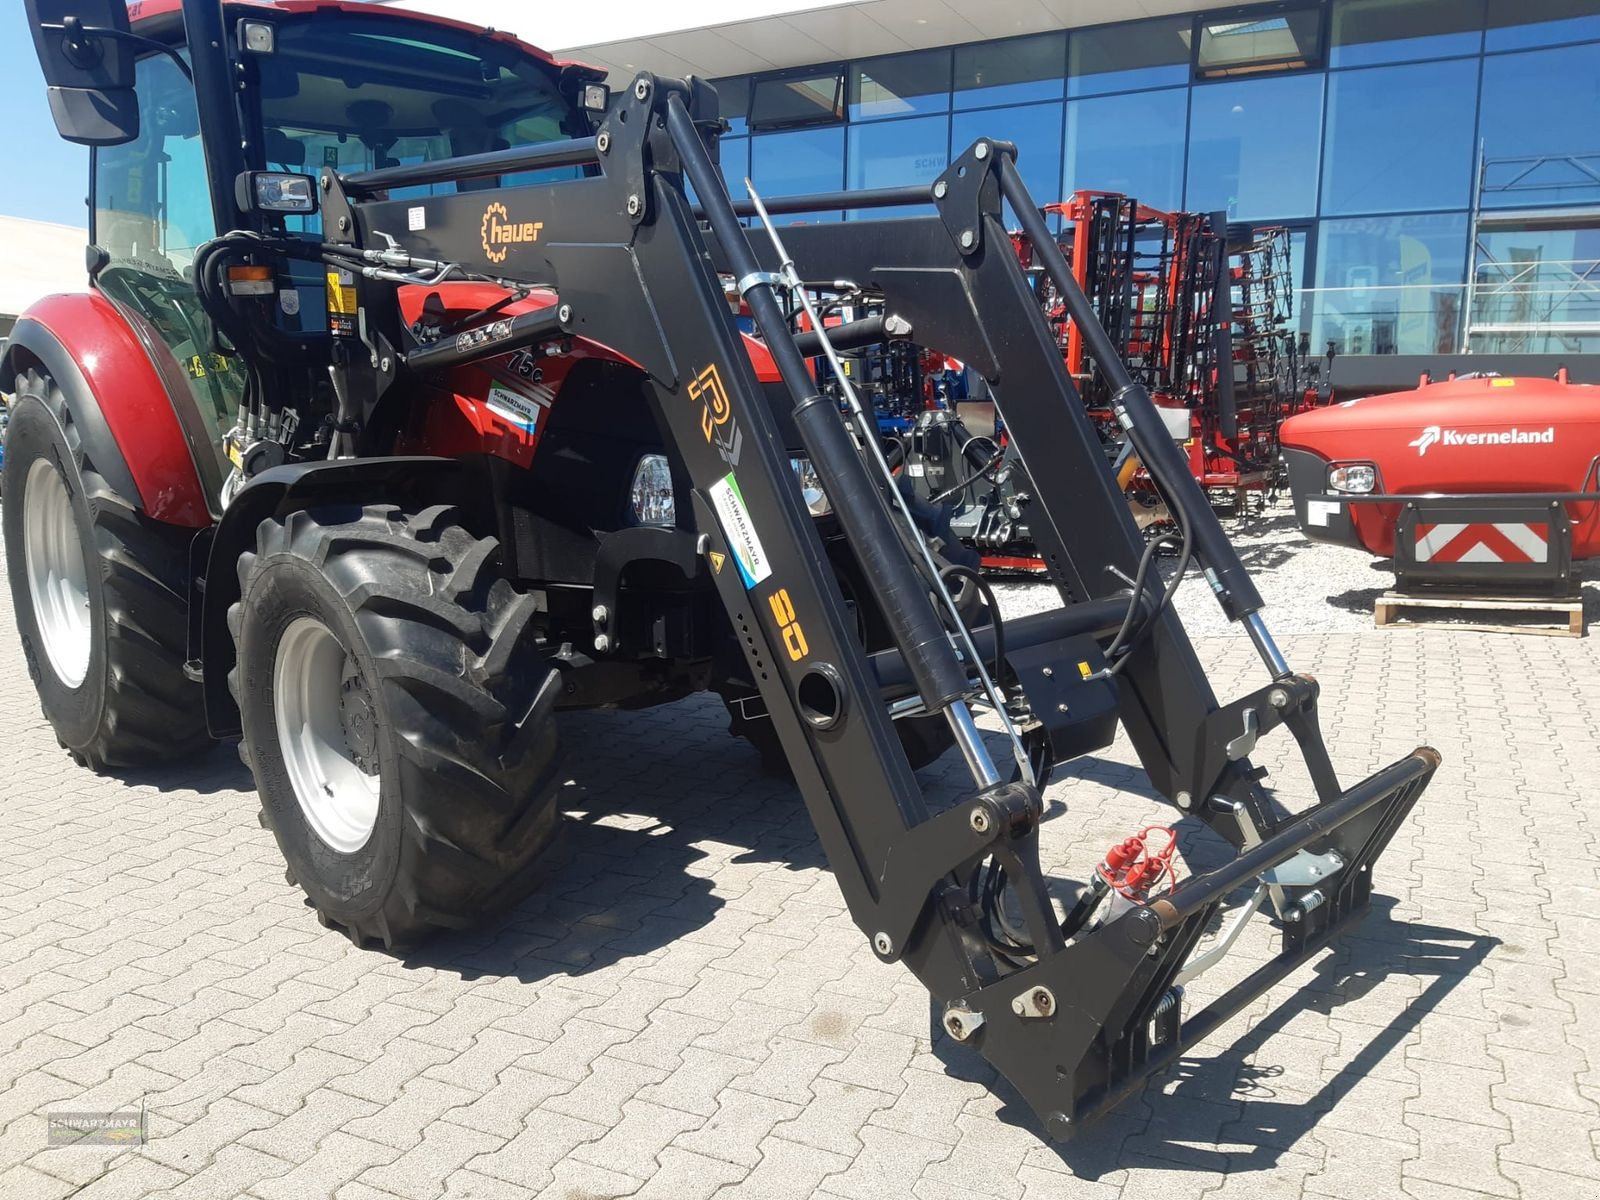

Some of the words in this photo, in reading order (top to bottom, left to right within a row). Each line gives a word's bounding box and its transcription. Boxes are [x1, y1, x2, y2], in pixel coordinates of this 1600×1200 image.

[491, 216, 544, 244] hauer
[494, 389, 532, 414] SCHWARZMAYR
[1443, 427, 1554, 446] Kverneland
[725, 487, 760, 567] SCHWARZMAYR
